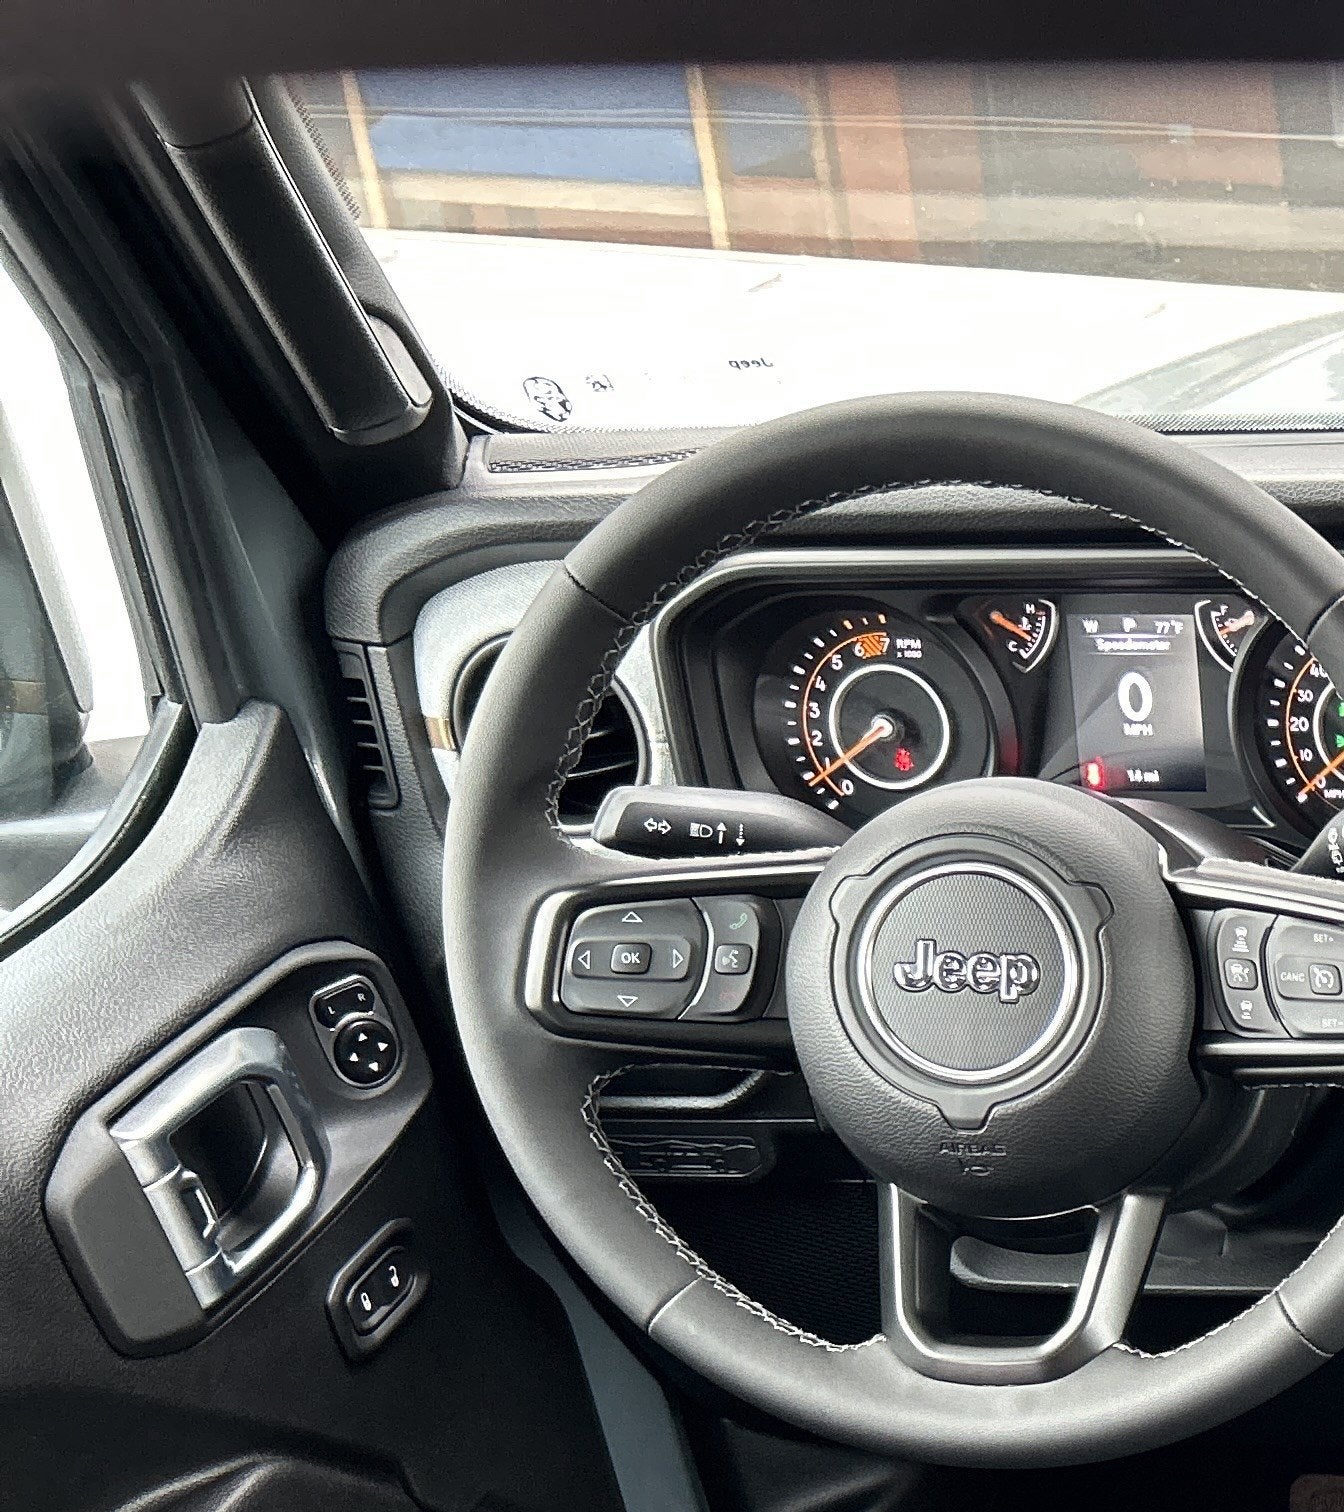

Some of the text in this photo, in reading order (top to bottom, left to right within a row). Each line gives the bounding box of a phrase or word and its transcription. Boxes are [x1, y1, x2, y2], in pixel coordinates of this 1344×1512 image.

[1025, 603, 1035, 613] H
[1220, 604, 1229, 615] F
[1082, 619, 1099, 633] W
[1122, 617, 1137, 632] P
[854, 641, 864, 657] 6
[880, 637, 890, 652] 7
[896, 638, 922, 650] RPM
[1008, 640, 1018, 652] C
[1095, 638, 1171, 652] Speedometer
[831, 654, 843, 670] 5
[814, 676, 826, 692] 4
[1118, 671, 1153, 722] 0
[1297, 689, 1314, 703] 30
[808, 702, 820, 719] 3
[1123, 723, 1154, 736] MPH
[1289, 717, 1310, 732] 20
[811, 730, 823, 745] 2
[1299, 748, 1313, 762] 10
[841, 779, 854, 795] 0
[620, 952, 641, 964] OK
[893, 938, 1041, 1004] Jeep
[1280, 972, 1305, 982] CANC
[357, 993, 366, 1002] R
[328, 1006, 336, 1015] L
